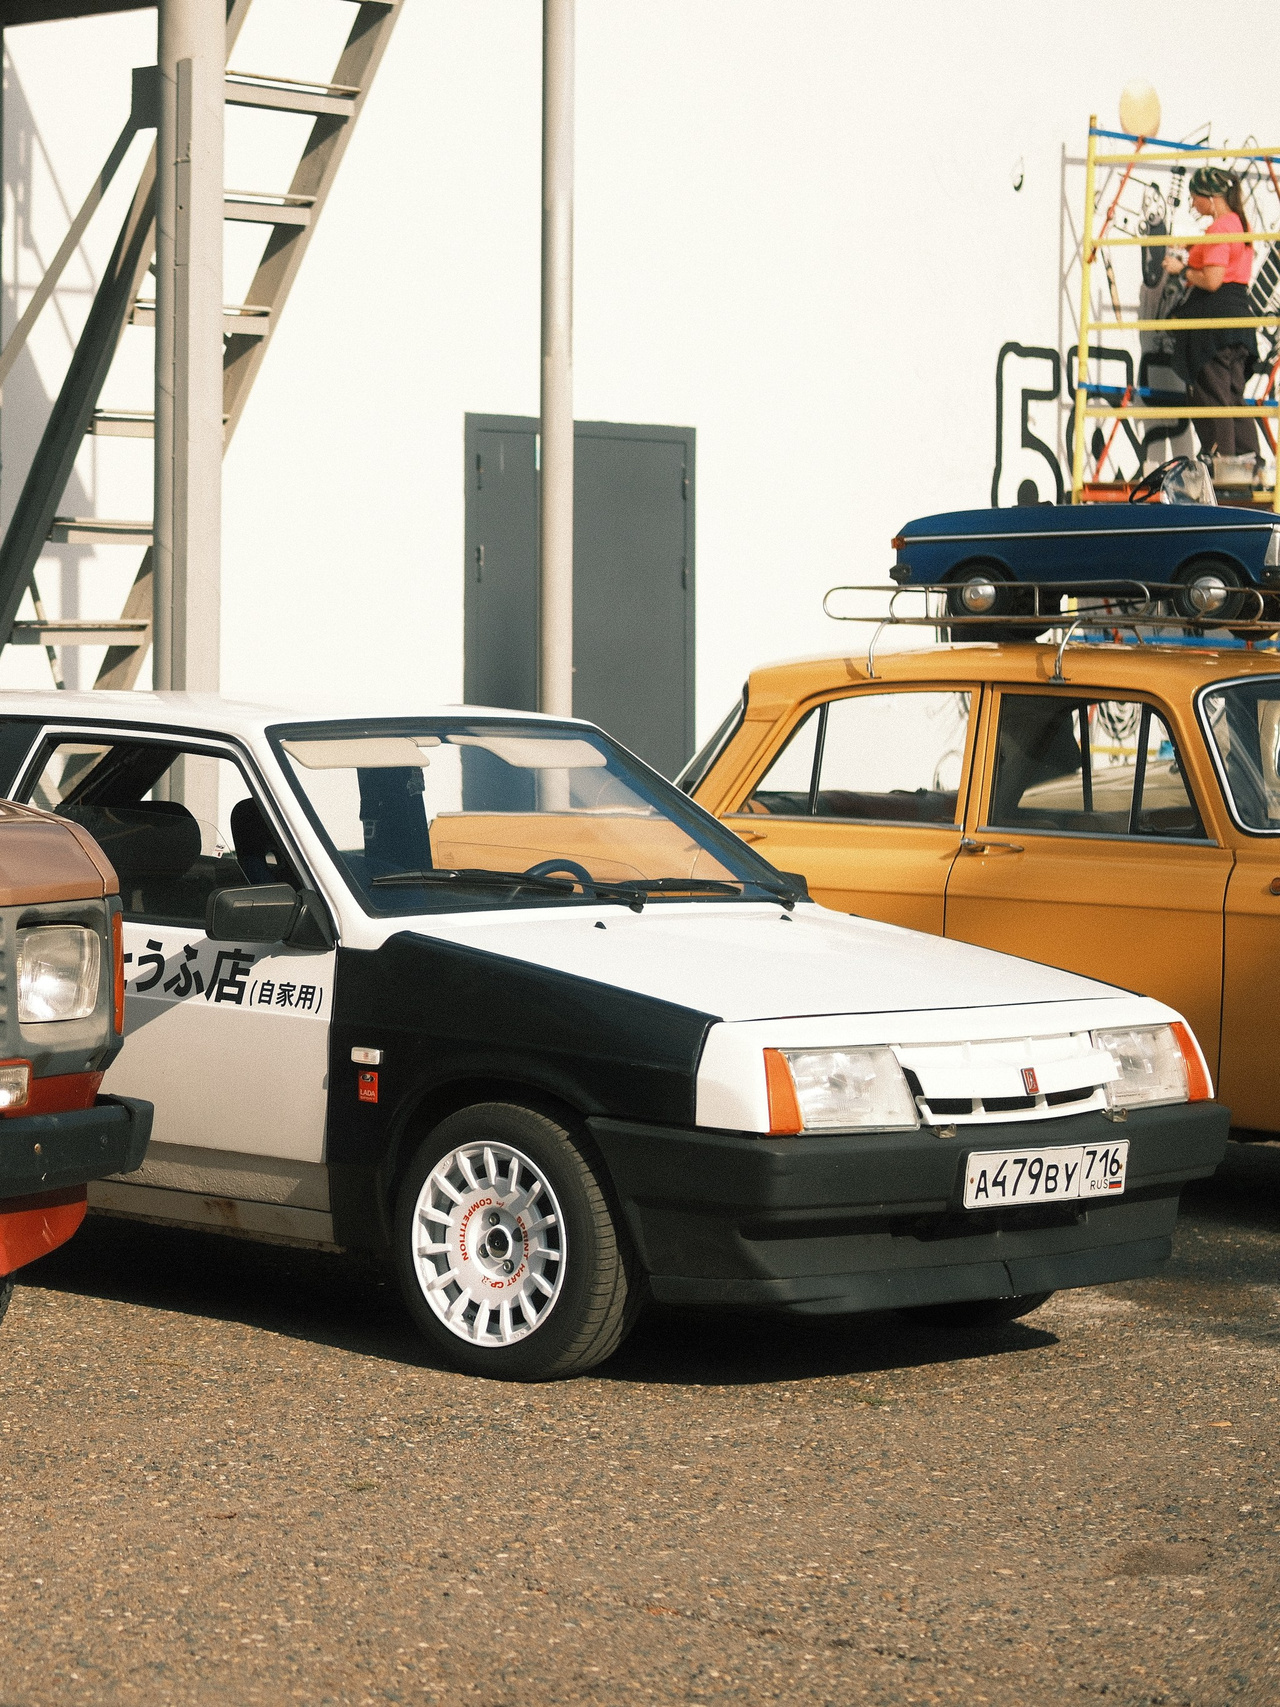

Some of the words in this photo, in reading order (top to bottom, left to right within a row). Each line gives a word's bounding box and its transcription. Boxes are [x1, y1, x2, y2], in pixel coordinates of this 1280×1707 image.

[360, 1089, 375, 1097] LADA
[1085, 1148, 1120, 1179] 716
[1090, 1178, 1108, 1191] RUS
[459, 1197, 492, 1261] COMPETITION
[516, 1215, 529, 1260] SPRINT
[507, 1263, 525, 1287] HART
